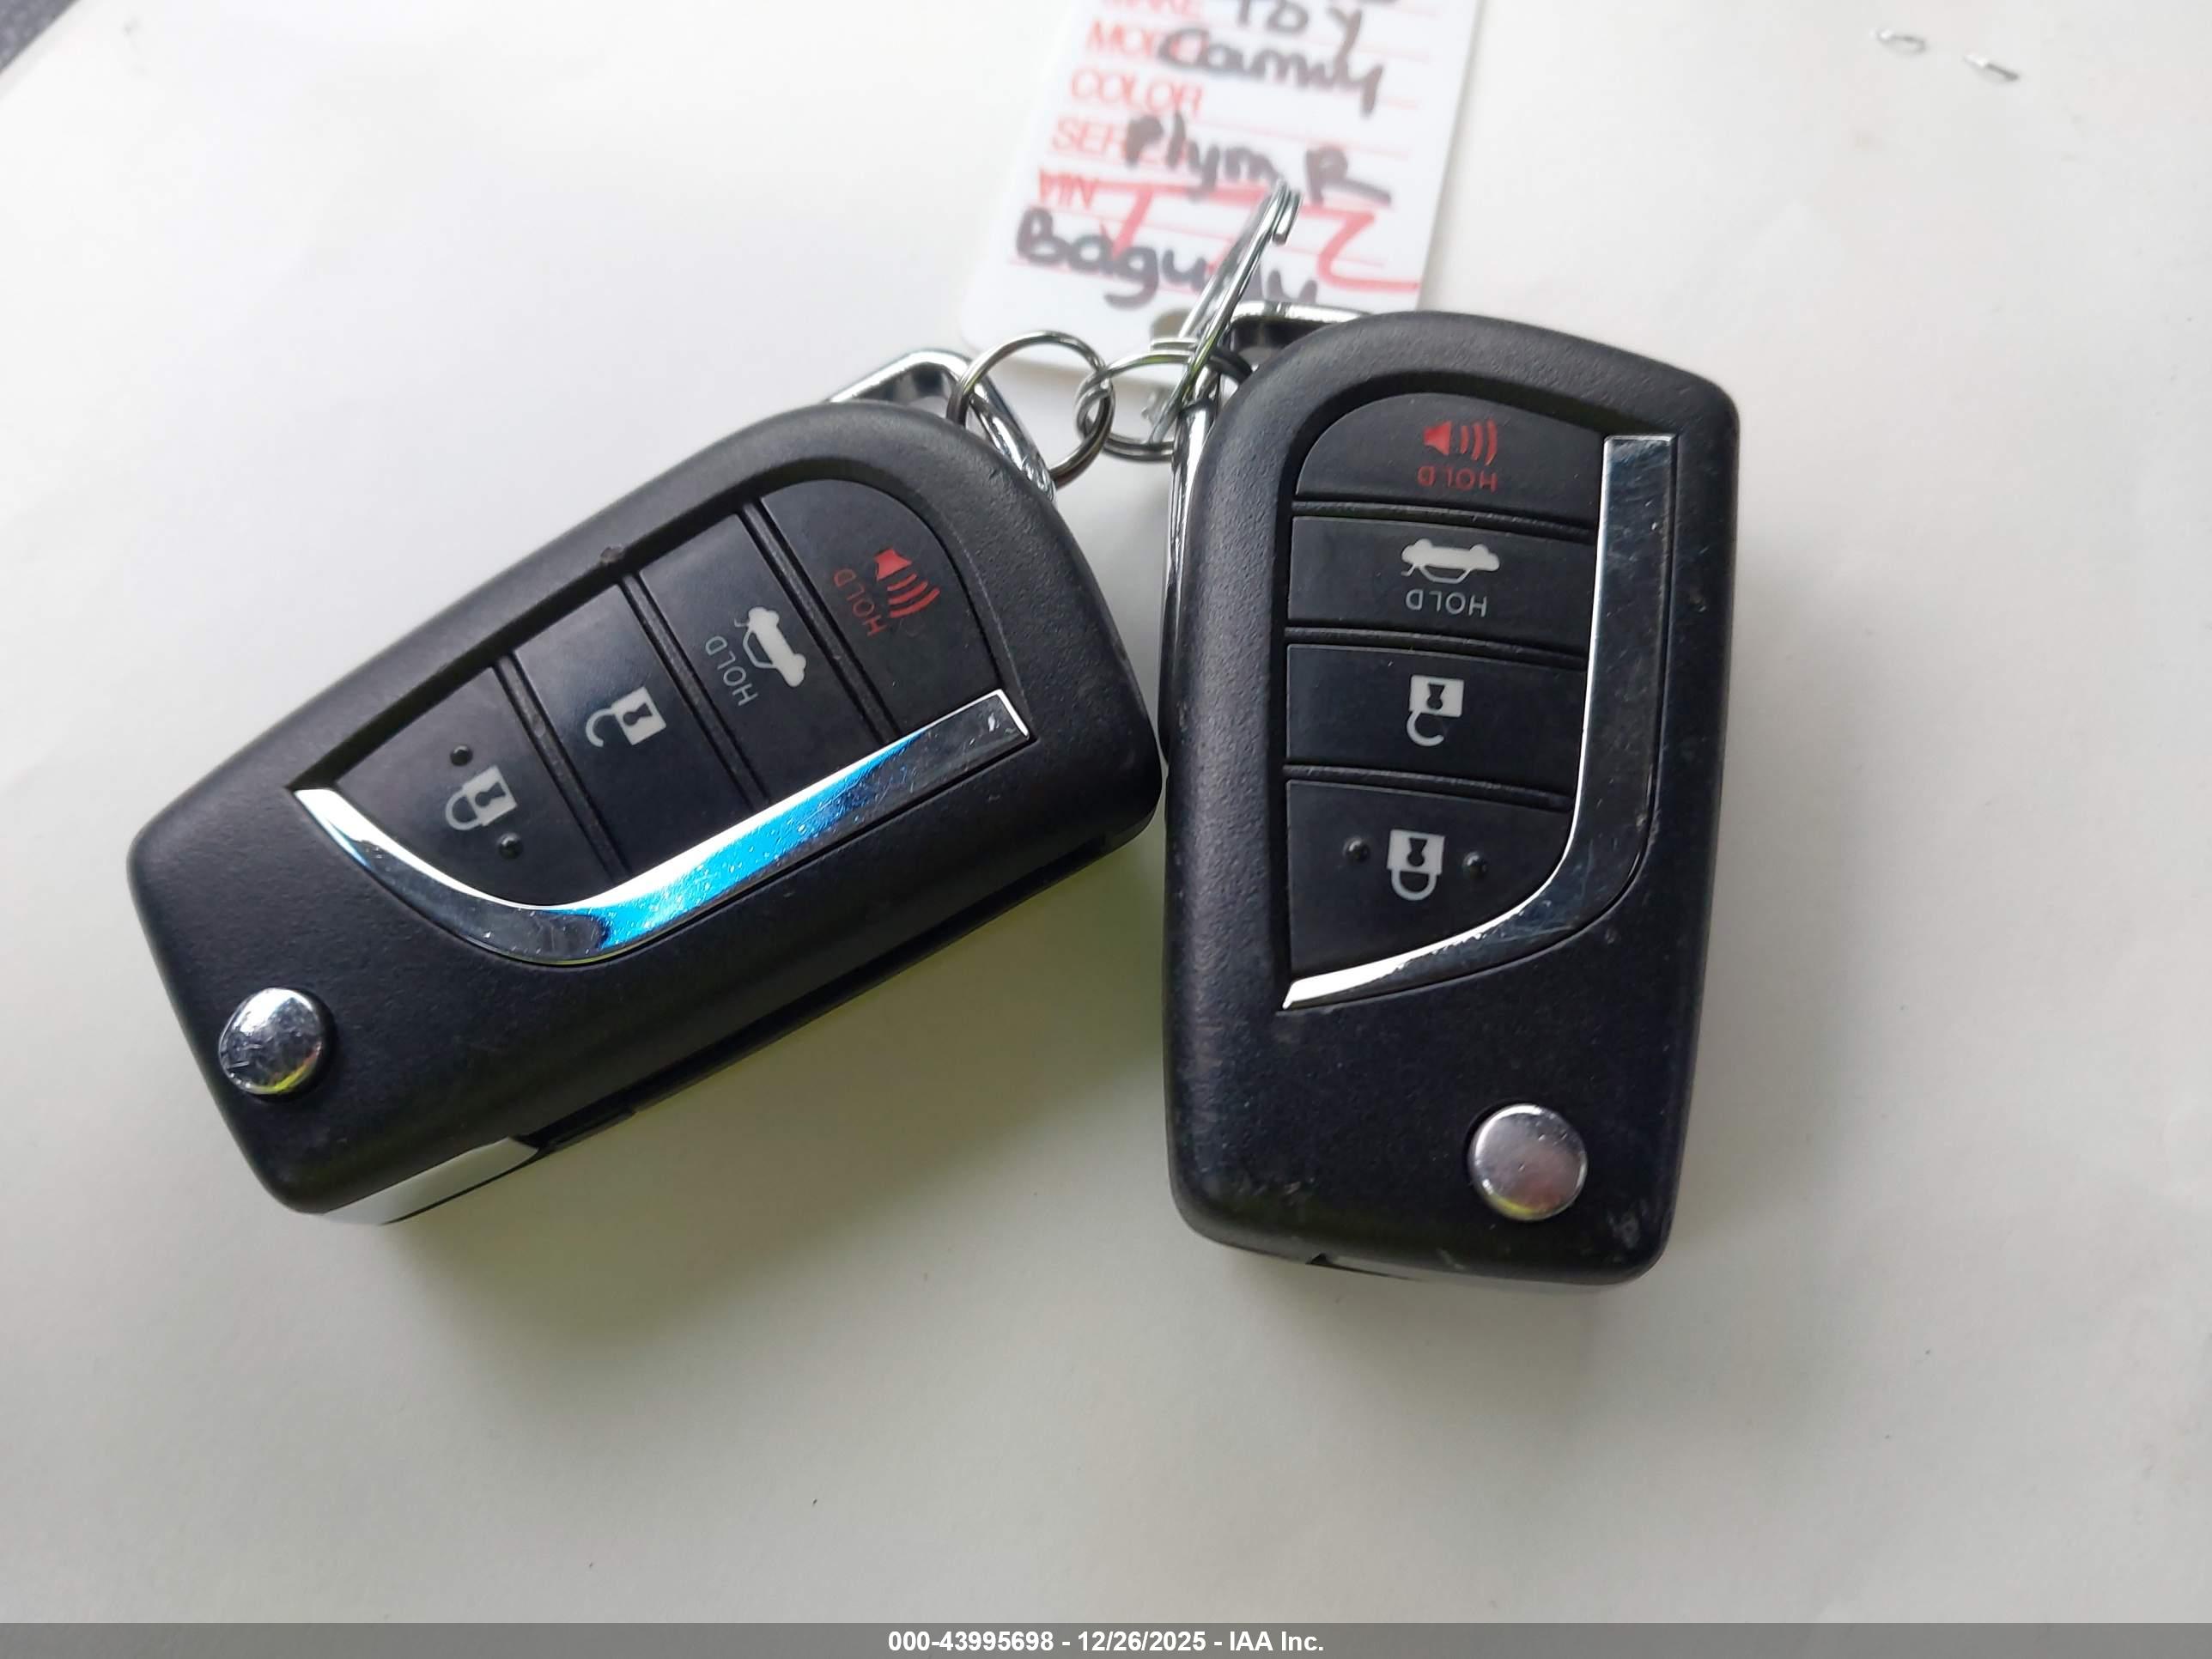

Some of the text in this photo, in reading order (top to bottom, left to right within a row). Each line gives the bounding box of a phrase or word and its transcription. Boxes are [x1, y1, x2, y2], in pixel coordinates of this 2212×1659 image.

[1070, 67, 1203, 117] COLOR
[1418, 465, 1498, 492] HOLD
[833, 568, 888, 636] HOLD
[1406, 589, 1487, 617] HOLD
[705, 635, 758, 706] HOLD
